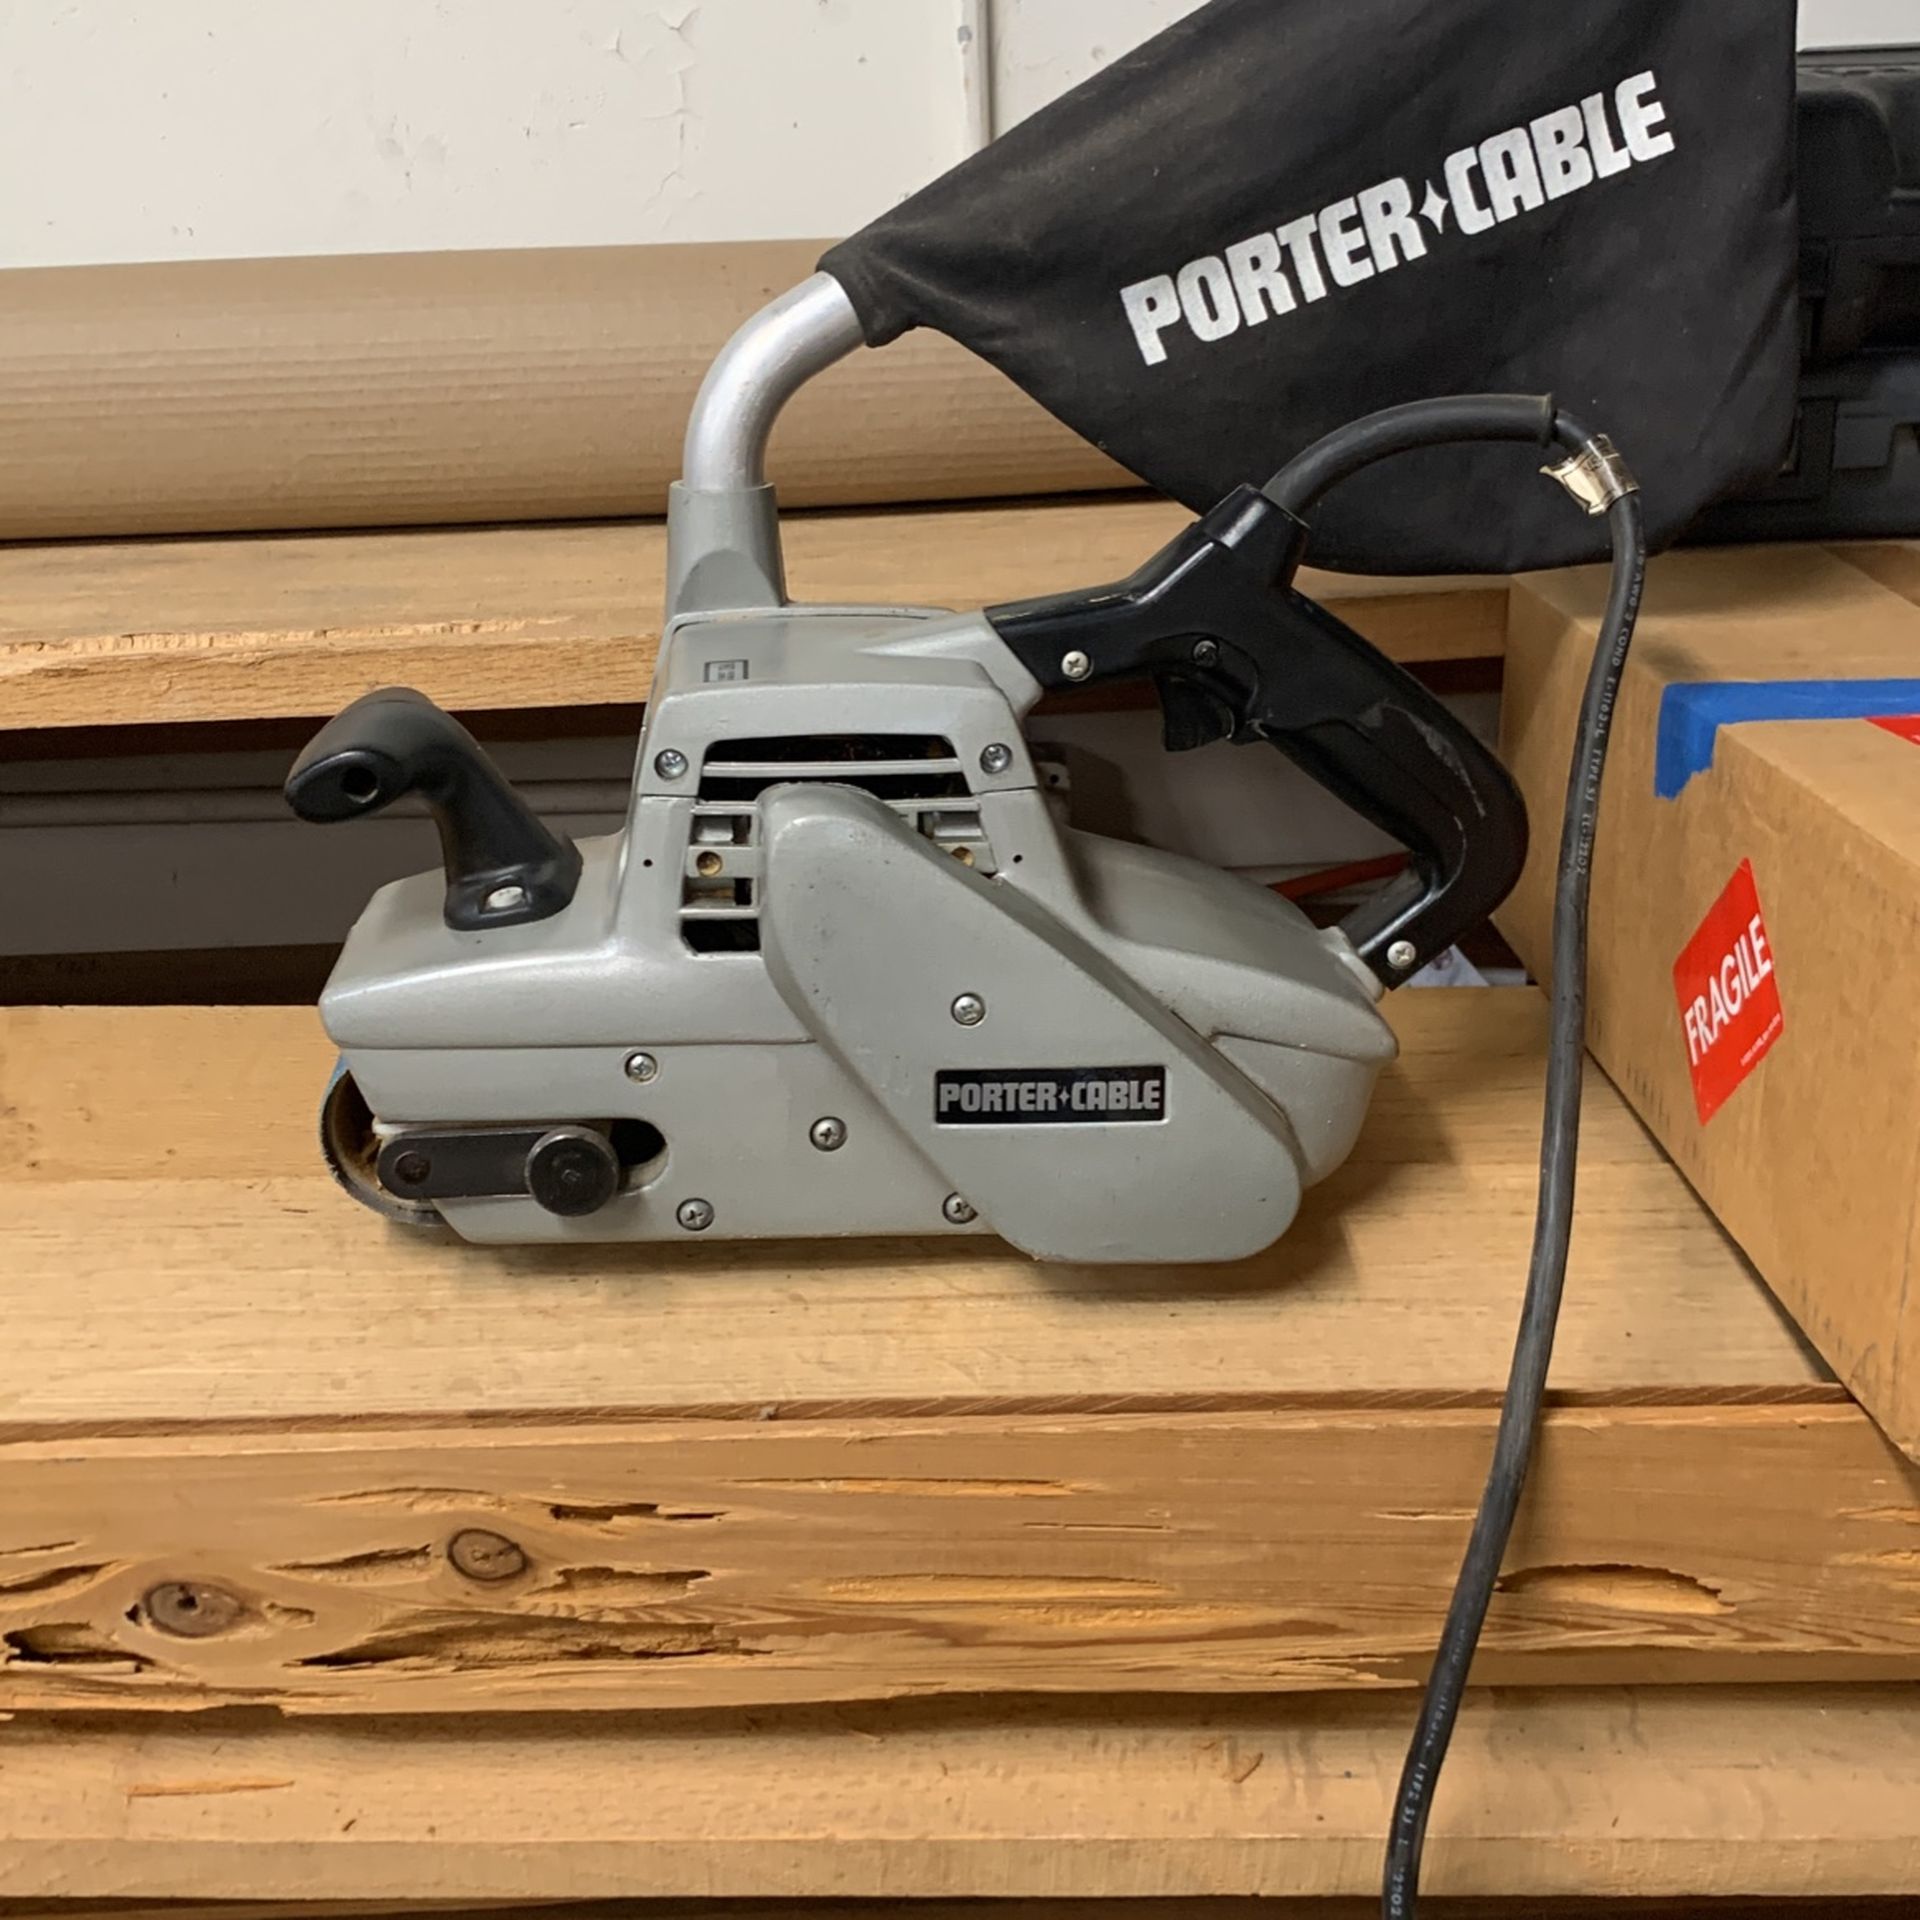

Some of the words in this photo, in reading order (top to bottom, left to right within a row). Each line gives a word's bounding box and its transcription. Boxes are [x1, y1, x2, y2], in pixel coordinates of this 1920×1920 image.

[1120, 176, 1427, 366] PORTER
[1443, 70, 1675, 236] CABLE
[1611, 627, 1629, 667] COND
[1684, 913, 1773, 1067] FRAGILE
[939, 1081, 1058, 1113] PORTER
[1070, 1079, 1161, 1111] CABLE
